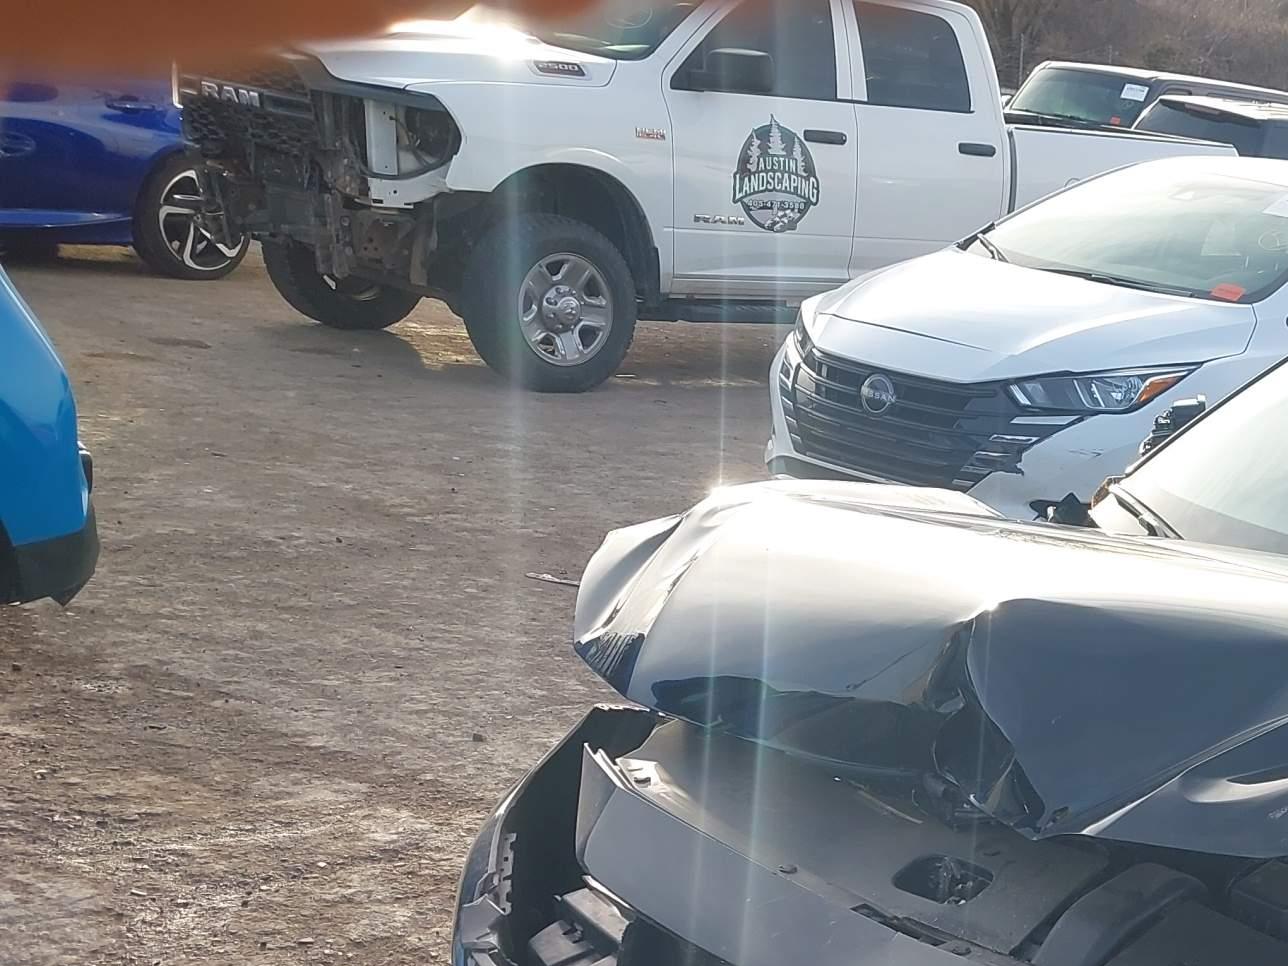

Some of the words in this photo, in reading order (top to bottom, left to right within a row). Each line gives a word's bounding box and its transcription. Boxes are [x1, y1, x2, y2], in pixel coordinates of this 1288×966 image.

[200, 81, 260, 107] RAM
[758, 157, 797, 174] AUSTIN
[735, 172, 819, 203] LANDSCAPING
[694, 214, 745, 225] RAM
